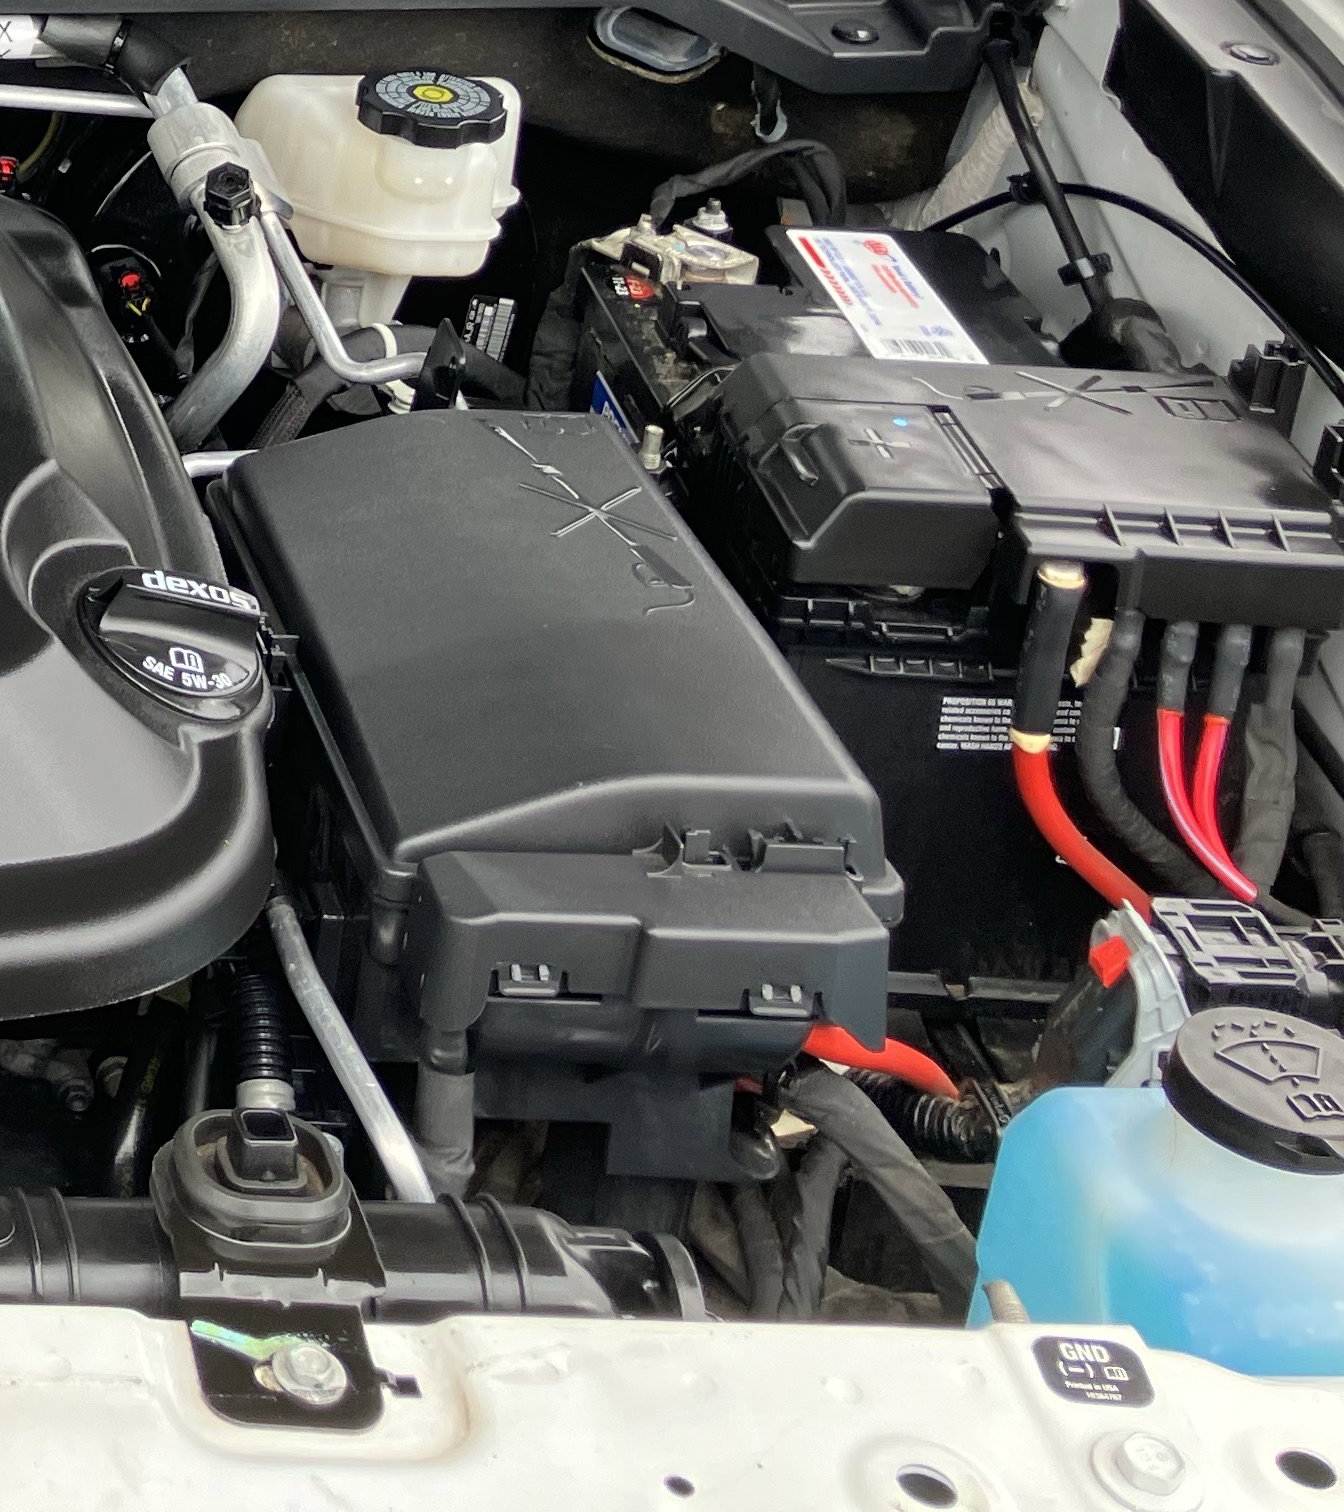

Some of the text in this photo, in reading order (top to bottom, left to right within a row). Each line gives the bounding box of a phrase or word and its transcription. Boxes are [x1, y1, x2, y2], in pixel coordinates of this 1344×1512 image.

[141, 570, 252, 611] dexos
[142, 655, 233, 690] SAE 5W-30
[1058, 1342, 1111, 1363] GND
